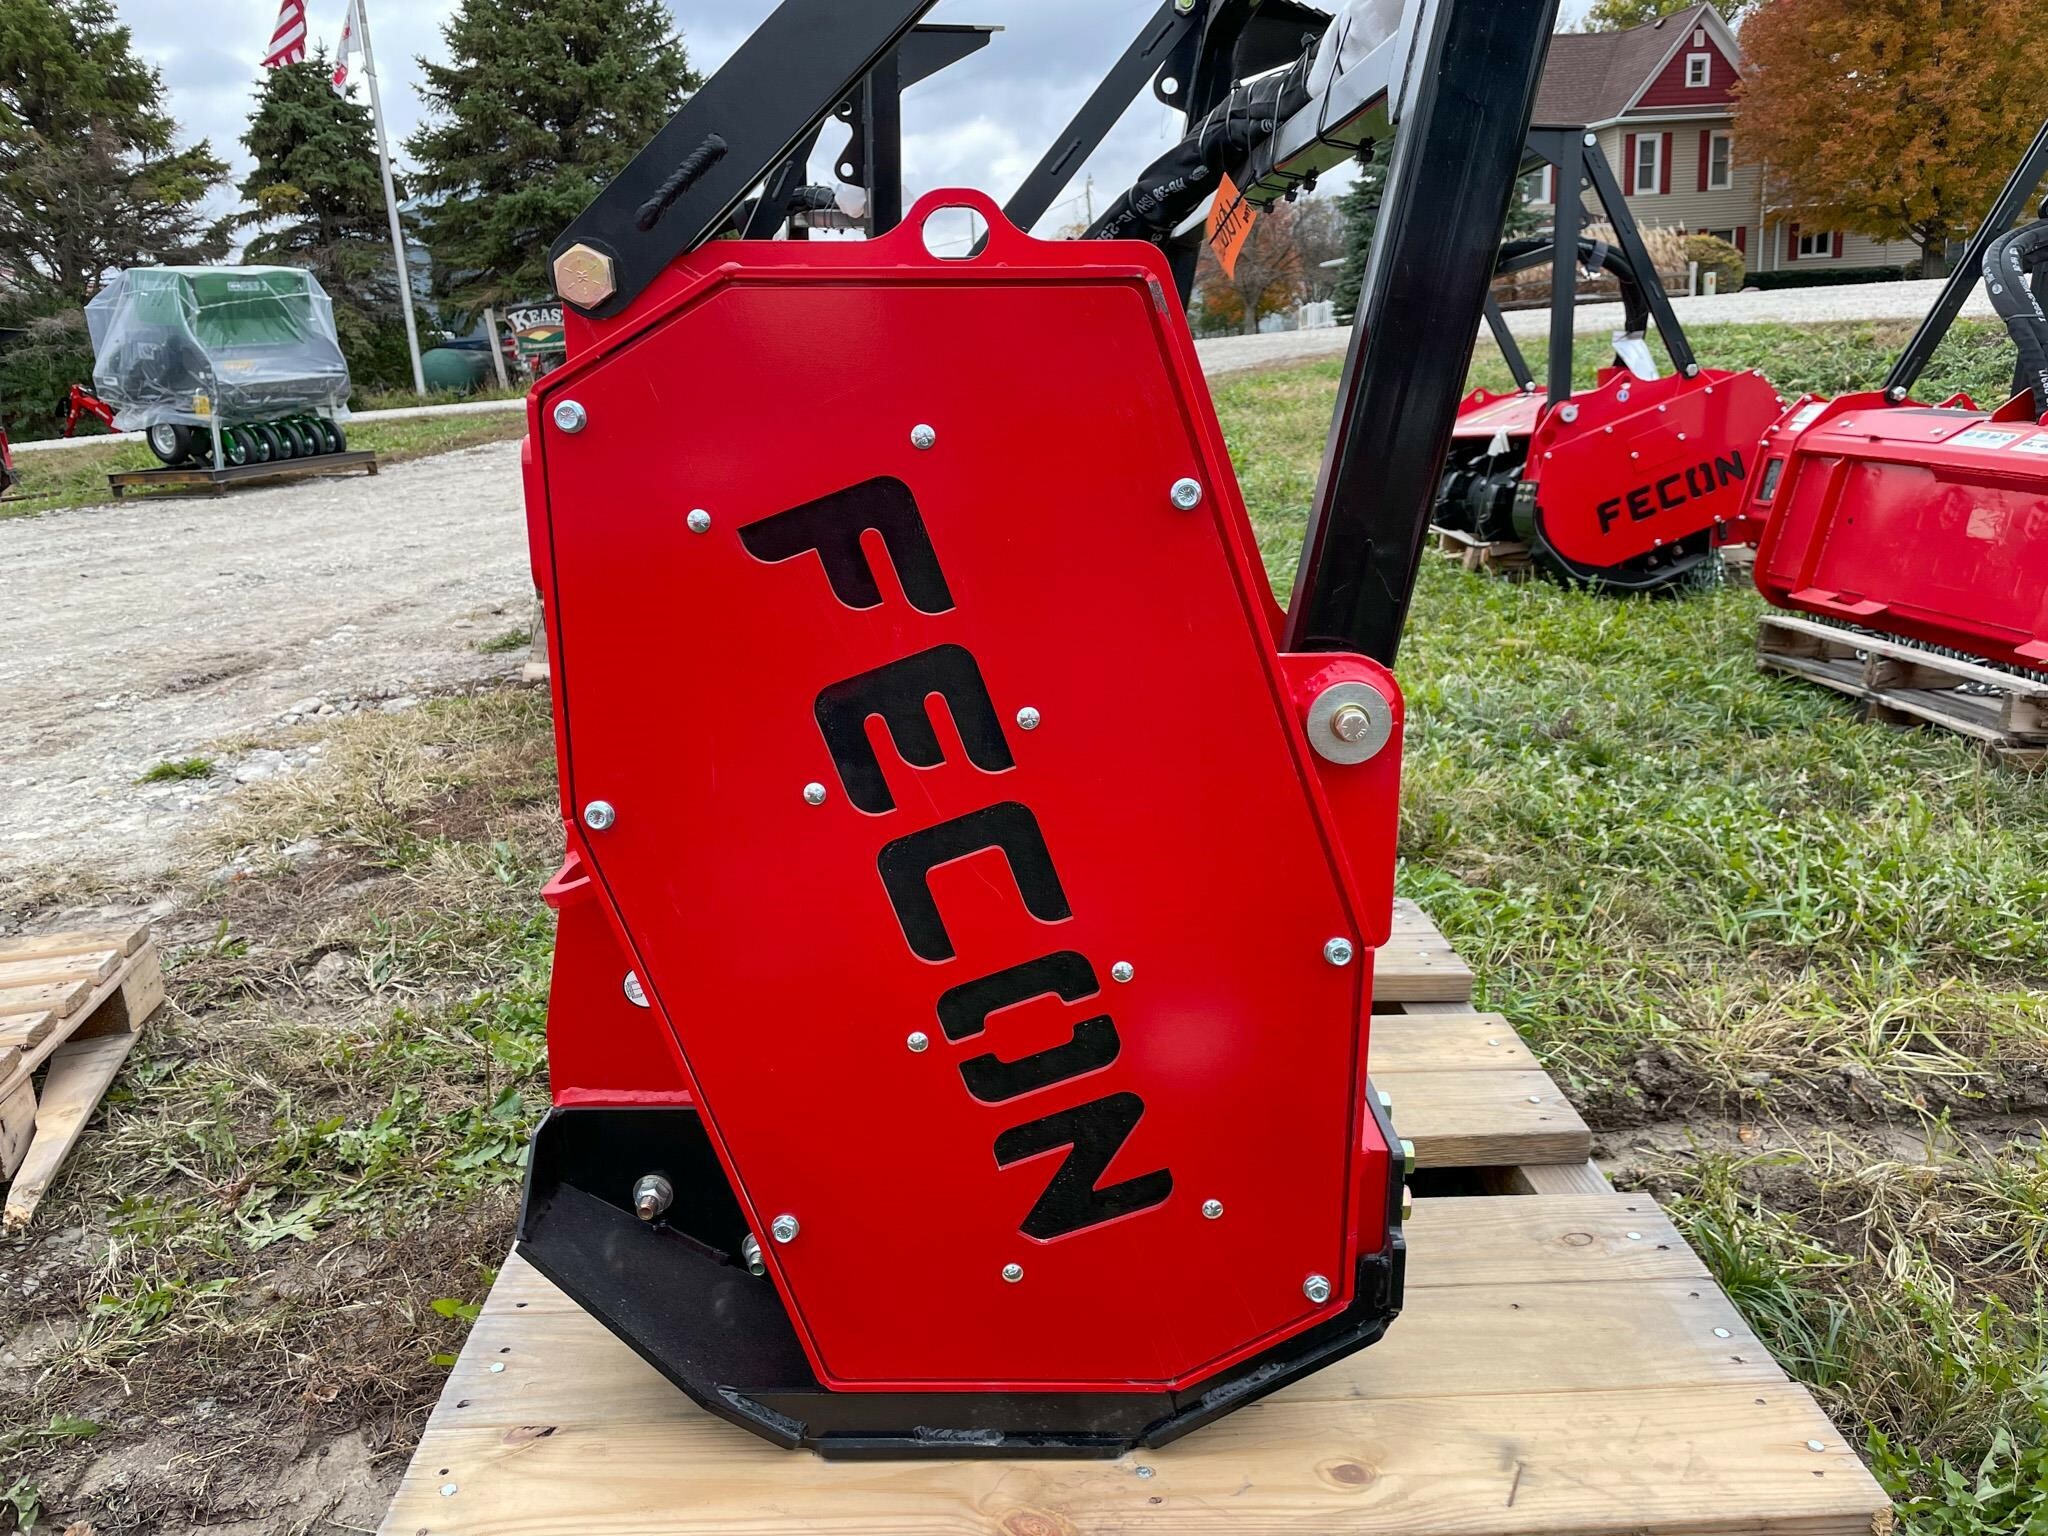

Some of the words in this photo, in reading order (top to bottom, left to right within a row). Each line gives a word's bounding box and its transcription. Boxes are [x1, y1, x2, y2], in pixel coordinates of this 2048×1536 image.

[1096, 210, 1136, 240] IC-29
[508, 308, 563, 332] KEAS
[1597, 450, 1745, 535] FECON
[737, 475, 1173, 1244] FECON
